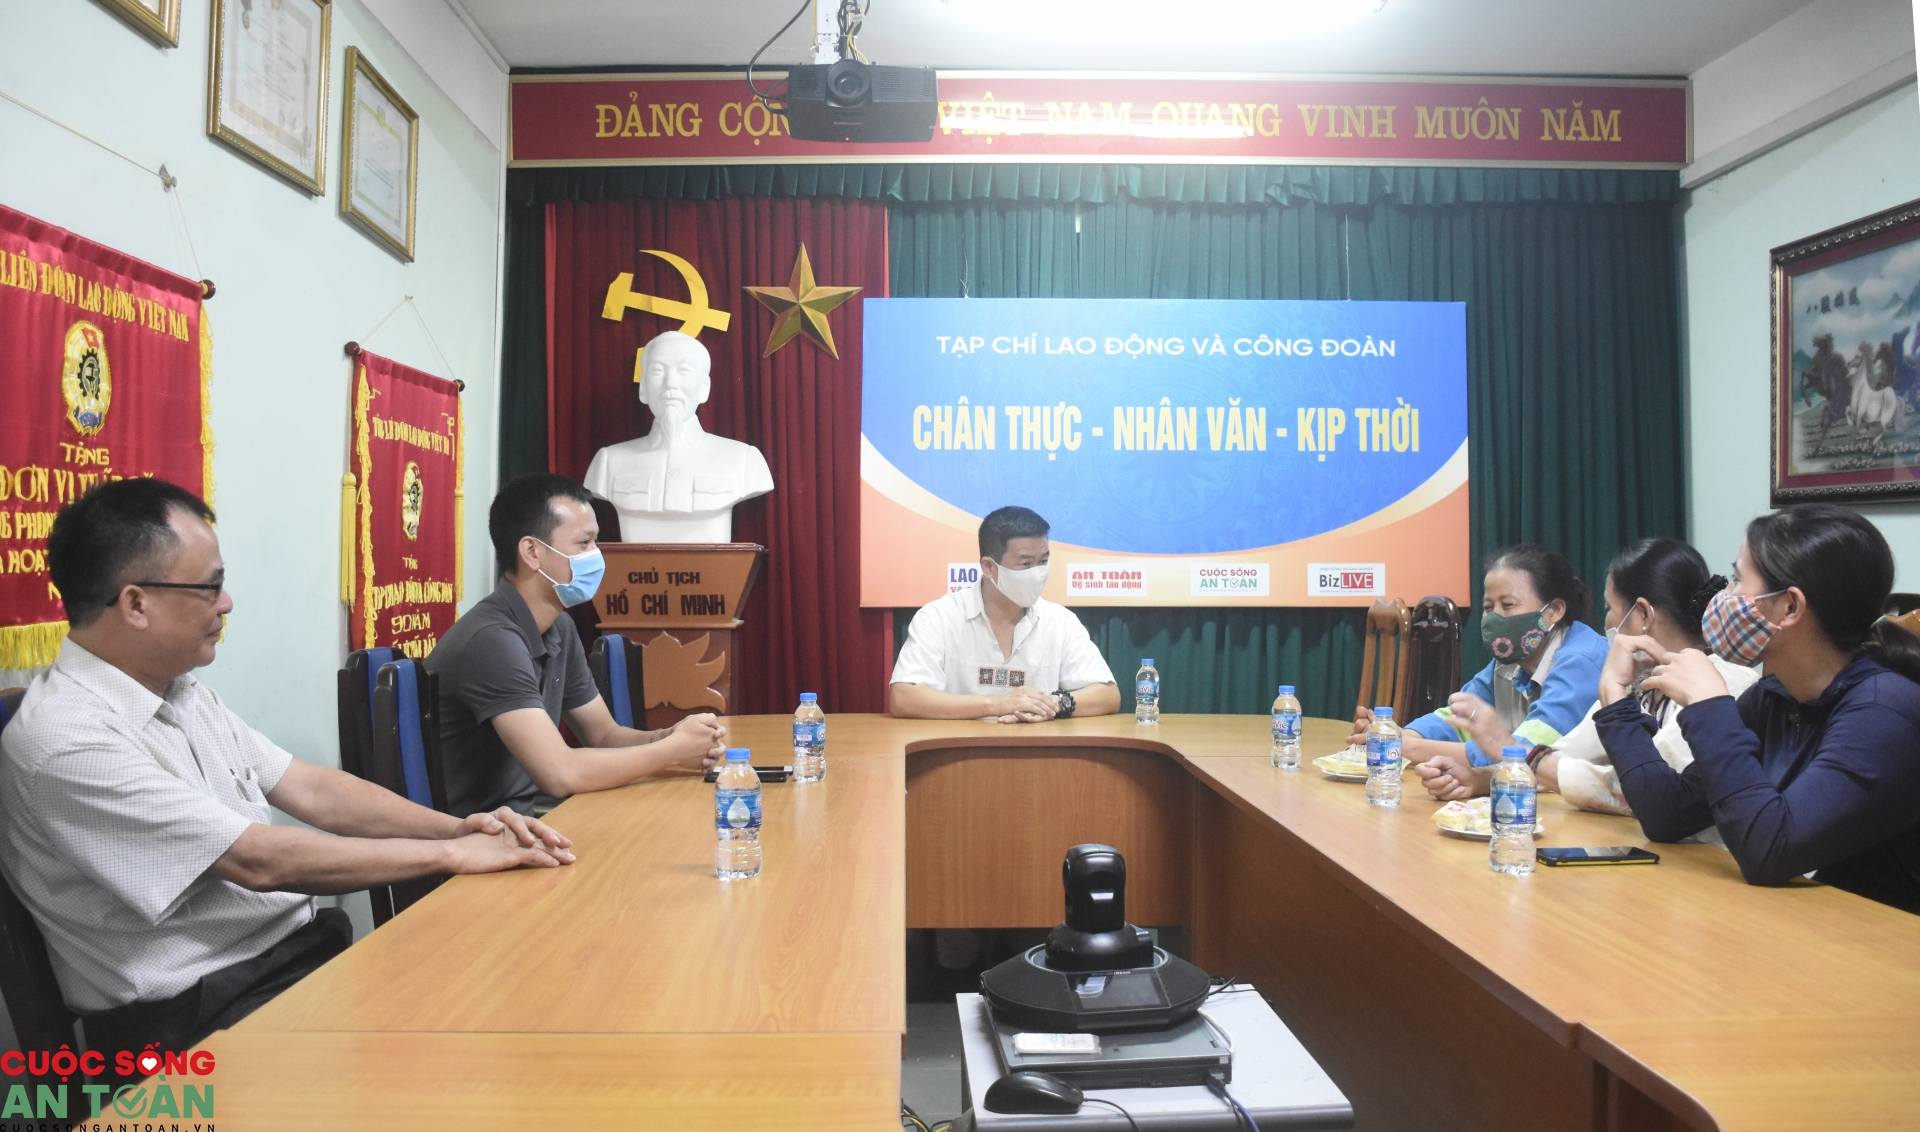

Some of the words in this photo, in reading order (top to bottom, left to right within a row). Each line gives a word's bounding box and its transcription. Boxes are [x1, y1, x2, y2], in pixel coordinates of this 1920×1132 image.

[595, 91, 702, 138] ĐẢNG
[719, 94, 791, 146] CỘN
[937, 91, 1026, 145] VIỆT
[1044, 101, 1134, 136] NAM
[1151, 102, 1282, 138] QUANG
[1297, 104, 1396, 139] VINH
[1414, 96, 1522, 142] MUÔN
[1540, 100, 1622, 143] NĂM
[78, 276, 102, 313] LAO
[103, 283, 136, 324] ĐỘNG
[138, 297, 167, 335] VIỆT
[168, 308, 190, 342] NAM
[936, 335, 988, 360] TẠP
[992, 331, 1038, 355] CHÍ
[1045, 335, 1097, 355] LAO
[1104, 333, 1186, 360] ĐỘNG
[1192, 333, 1228, 356] VÀ
[1233, 333, 1314, 357] CÔNG
[1320, 334, 1397, 358] ĐOÀN
[913, 395, 996, 451] CHÂN
[1005, 401, 1082, 461] THỰC
[1113, 397, 1197, 452] NHÂN
[1206, 398, 1267, 452] VĂN
[1297, 407, 1346, 462] KỊP
[1355, 397, 1420, 453] THỜI
[8, 549, 51, 576] HOẠ
[1199, 568, 1228, 578] CUỘC
[1230, 566, 1258, 577] SỐNG
[628, 567, 659, 584] CHỦ
[665, 572, 700, 587] TỊCH
[951, 568, 978, 583] LAO
[1072, 571, 1094, 580] AN
[1100, 569, 1142, 580] TOÀN
[1085, 580, 1103, 589] sinh
[1106, 580, 1119, 589] lao
[1200, 578, 1218, 588] AN
[1319, 573, 1373, 588] BizLIVE
[606, 588, 629, 615] HỒ
[641, 590, 668, 615] CHÍ
[681, 594, 725, 616] MINH
